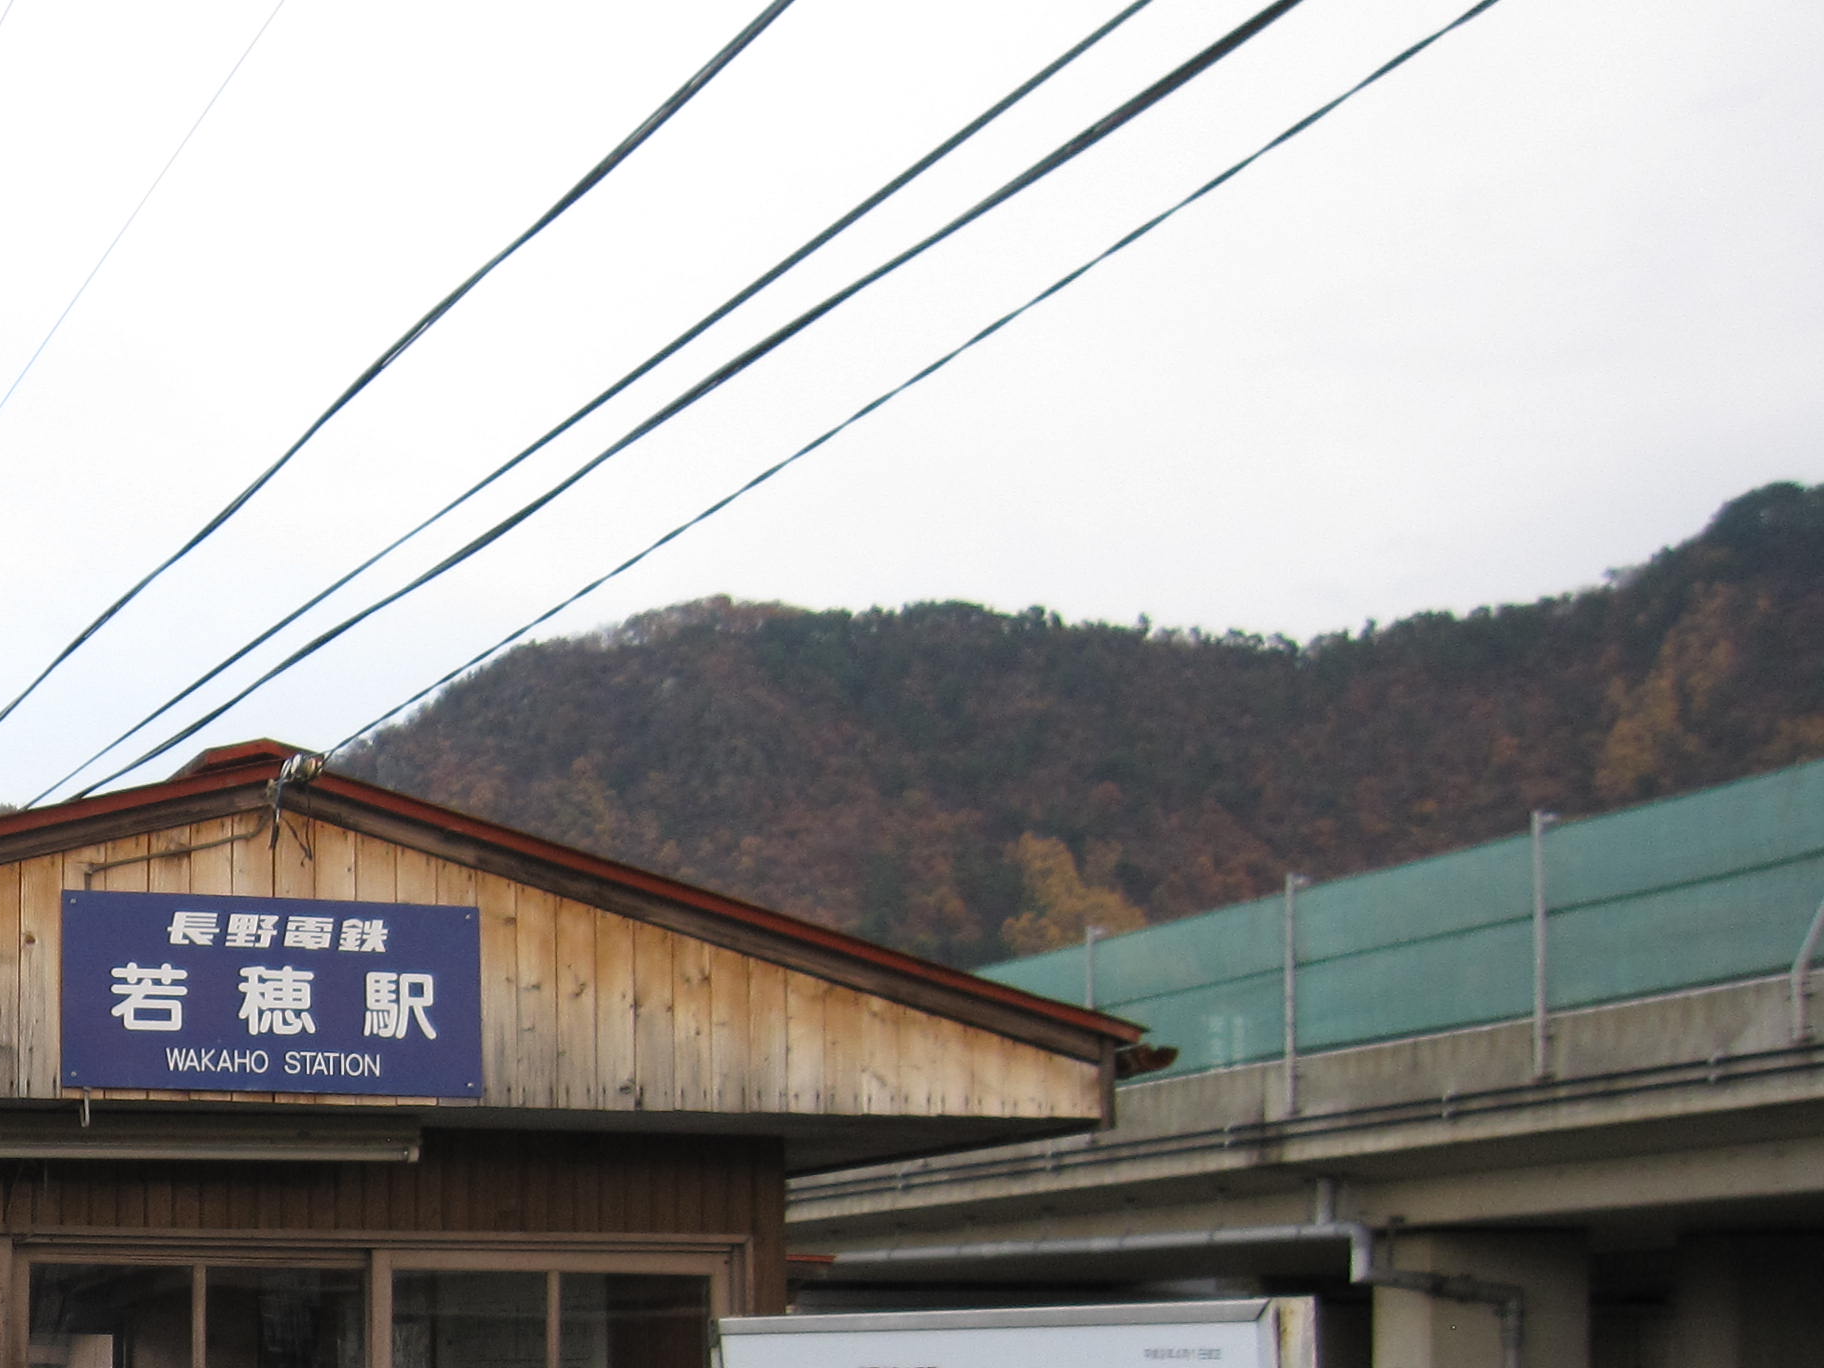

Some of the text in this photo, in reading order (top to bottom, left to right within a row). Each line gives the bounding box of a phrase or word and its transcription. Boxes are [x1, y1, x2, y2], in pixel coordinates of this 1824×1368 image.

[167, 911, 389, 953] 長野電鉄
[110, 962, 438, 1040] 若穂駅
[166, 1047, 380, 1078] WAKAHO STATION
